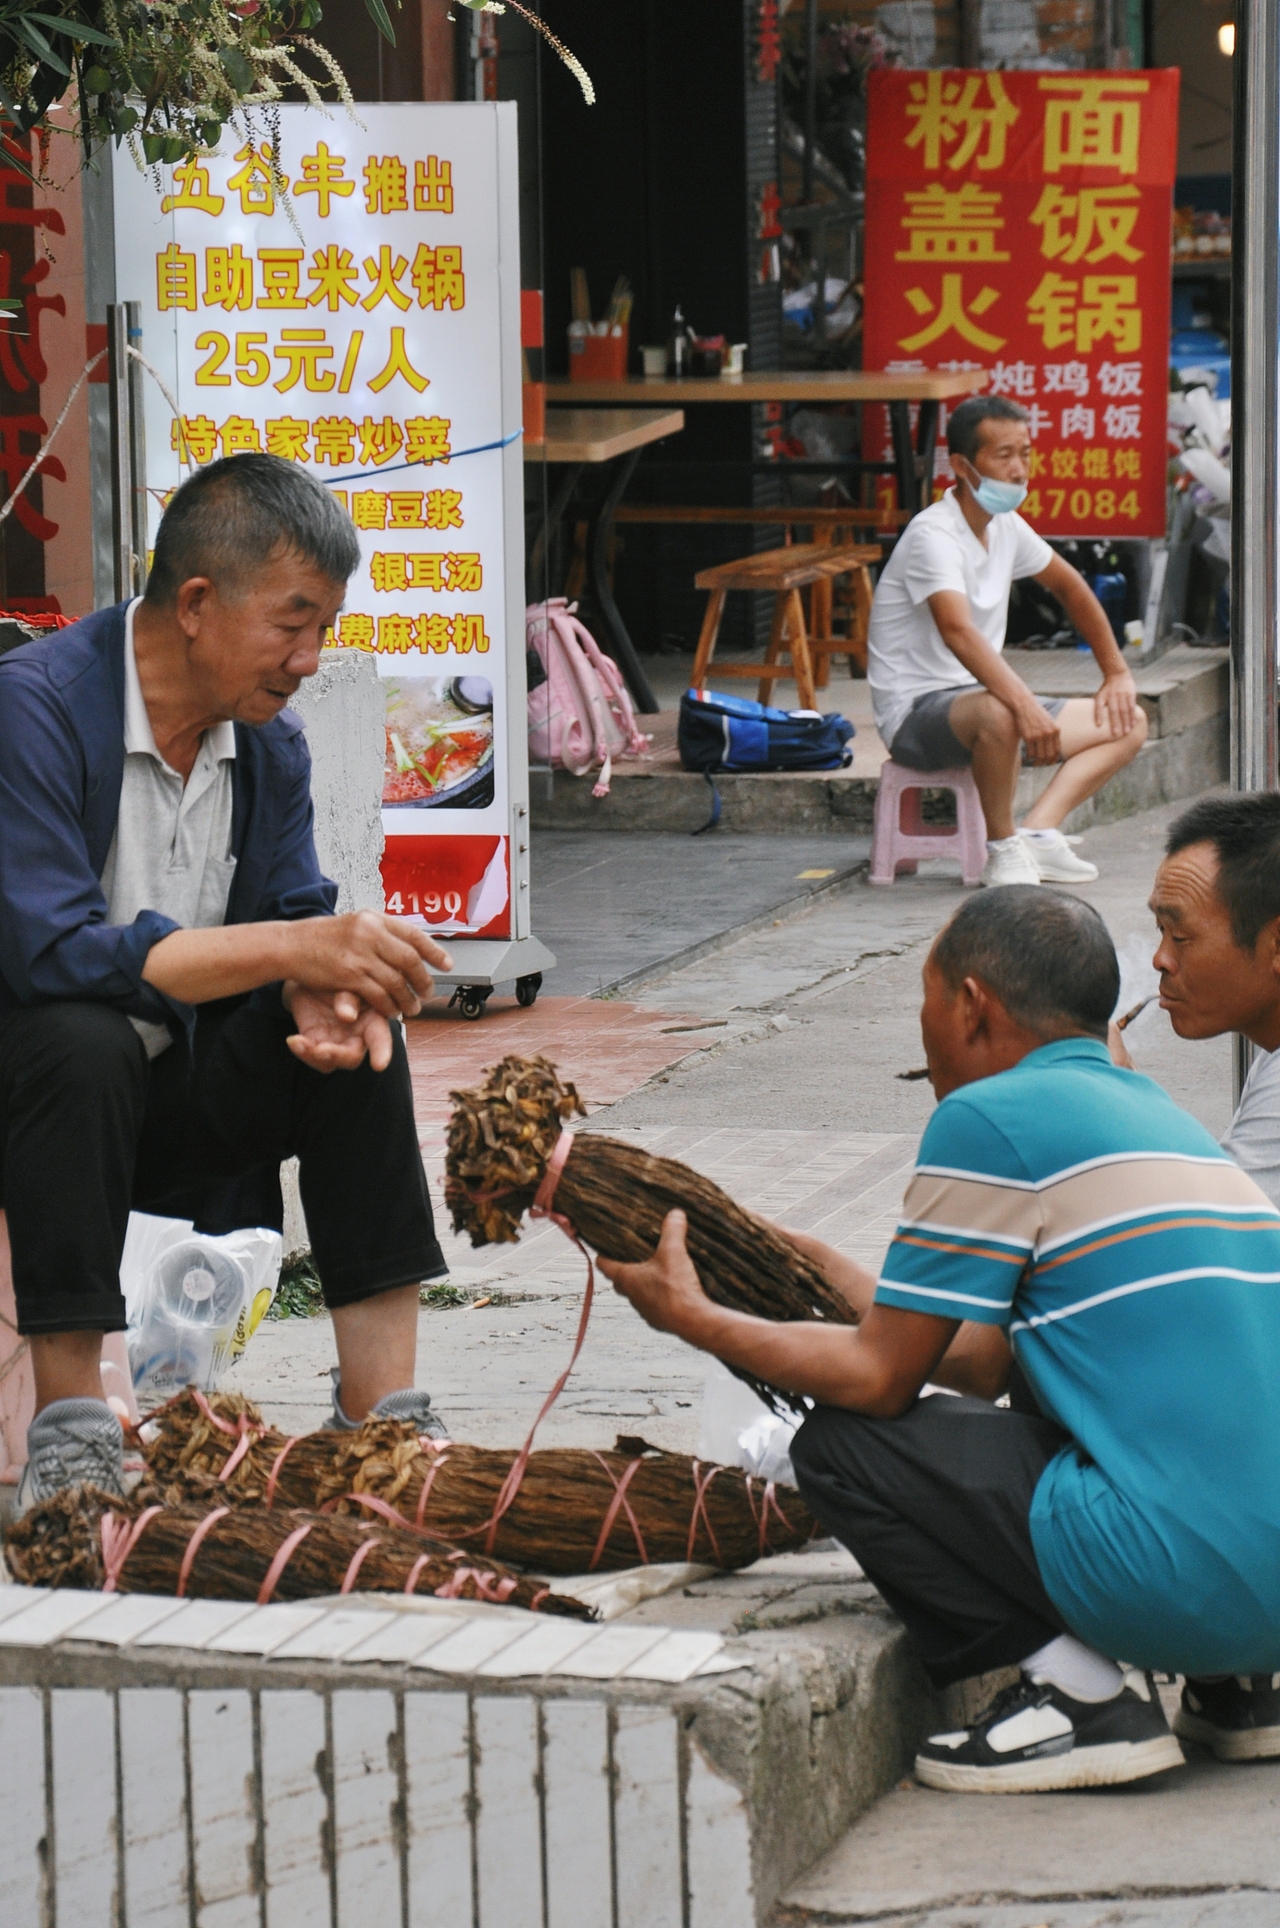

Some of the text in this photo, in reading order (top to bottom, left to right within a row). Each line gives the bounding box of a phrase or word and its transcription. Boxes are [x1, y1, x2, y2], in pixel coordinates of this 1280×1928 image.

[904, 71, 1149, 174] 粉面
[894, 184, 1145, 264] 盖饭
[156, 242, 465, 313] 自助豆米火锅
[897, 272, 1143, 354] 火锅
[195, 327, 431, 394] 25元/人
[171, 415, 452, 466] 特色家常炒菜
[331, 489, 464, 530] 磨豆浆
[370, 551, 483, 592] 银耳汤
[387, 891, 462, 914] 4190
